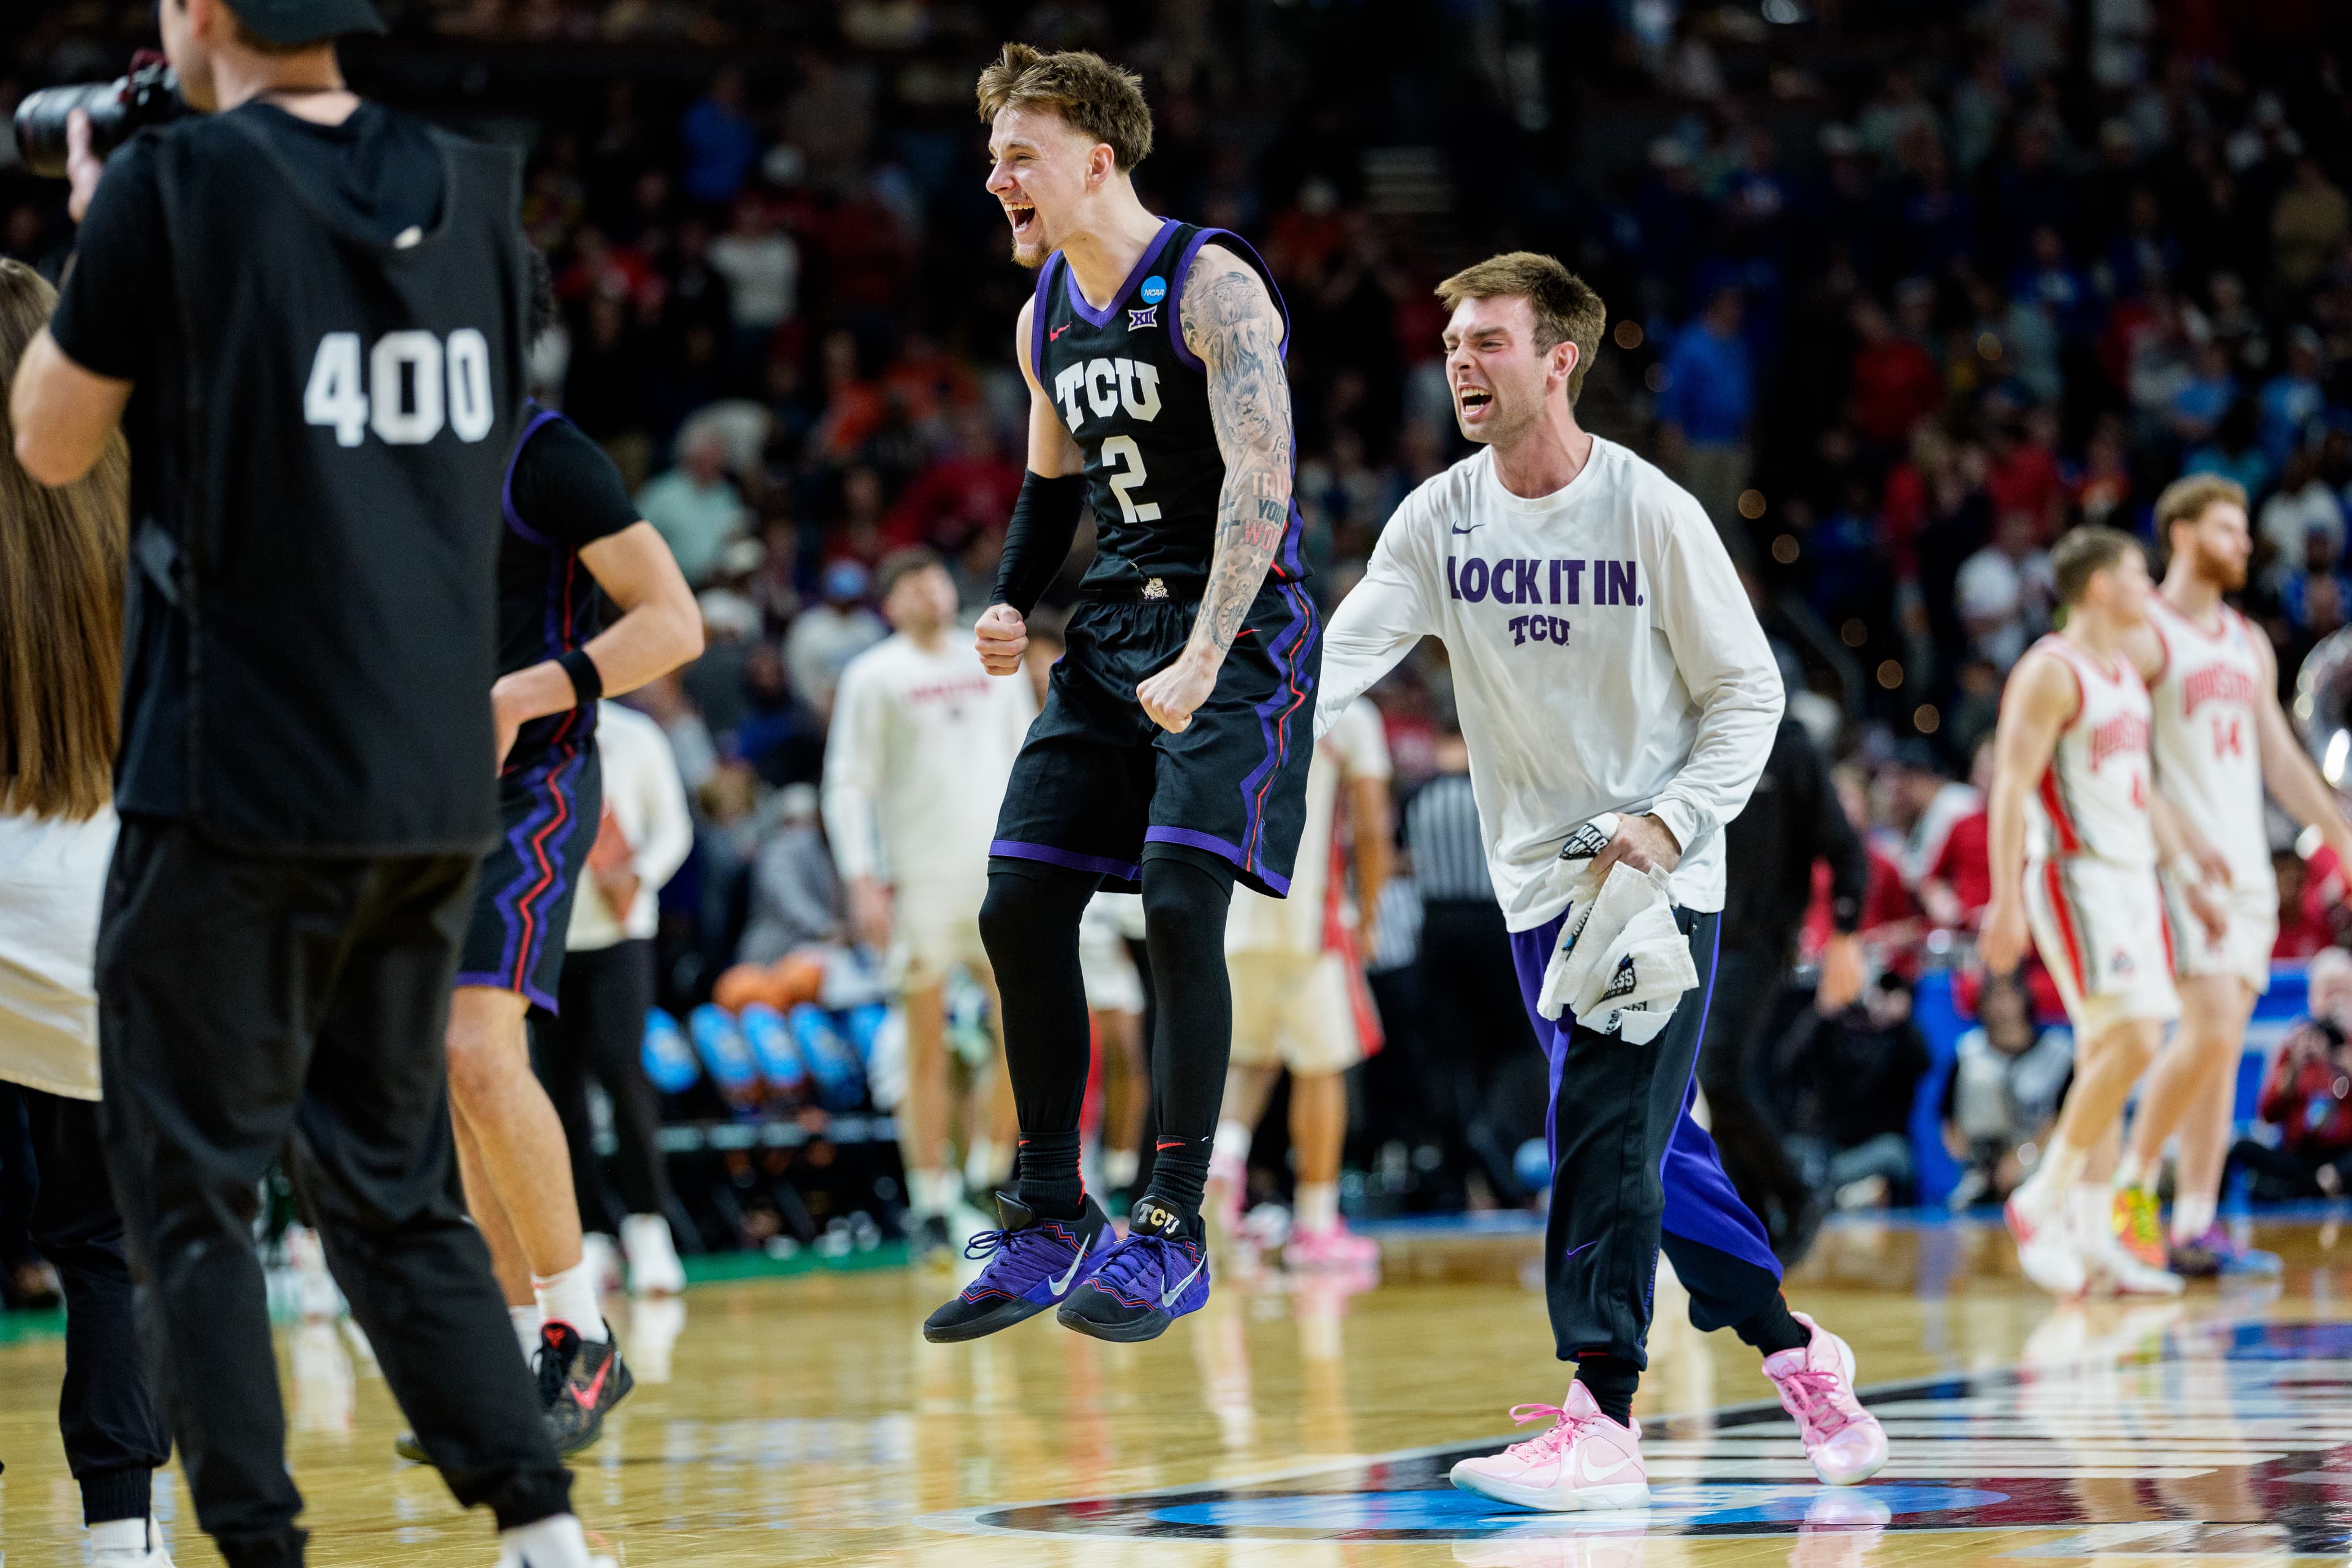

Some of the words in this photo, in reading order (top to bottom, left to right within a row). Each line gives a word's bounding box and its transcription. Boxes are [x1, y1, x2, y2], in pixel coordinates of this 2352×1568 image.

[1144, 288, 1164, 297] NCAA
[303, 328, 494, 447] 400
[1055, 358, 1161, 434] TCU
[1101, 435, 1161, 524] 2
[1447, 556, 1543, 605] LOCK
[1549, 559, 1586, 605] IT
[1594, 560, 1644, 607] IN.
[1509, 614, 1570, 647] TCU
[1575, 824, 1608, 853] MAR
[1137, 1203, 1180, 1234] TCU
